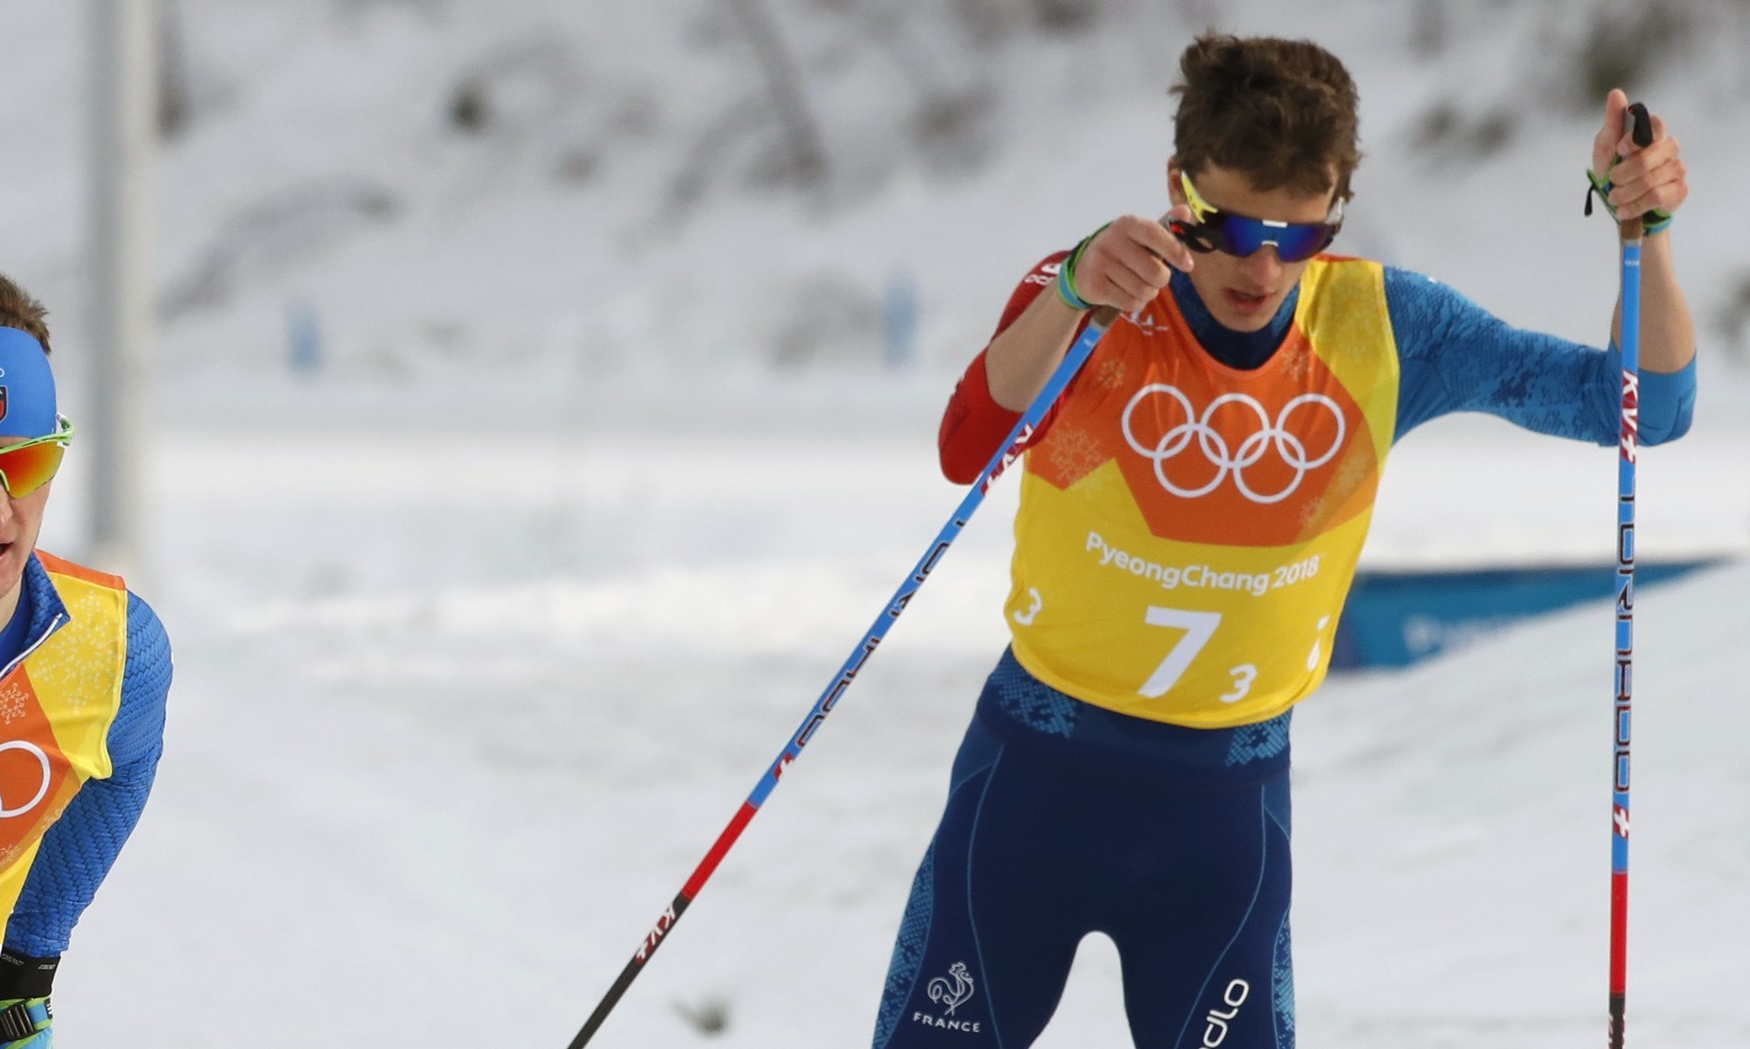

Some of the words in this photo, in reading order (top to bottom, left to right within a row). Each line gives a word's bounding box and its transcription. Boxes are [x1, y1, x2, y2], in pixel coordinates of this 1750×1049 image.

[1085, 531, 1270, 596] PyeongChang
[1272, 555, 1320, 588] 2018
[1137, 605, 1223, 699] 7
[1220, 663, 1258, 703] 3
[913, 1012, 981, 1033] FRANCE
